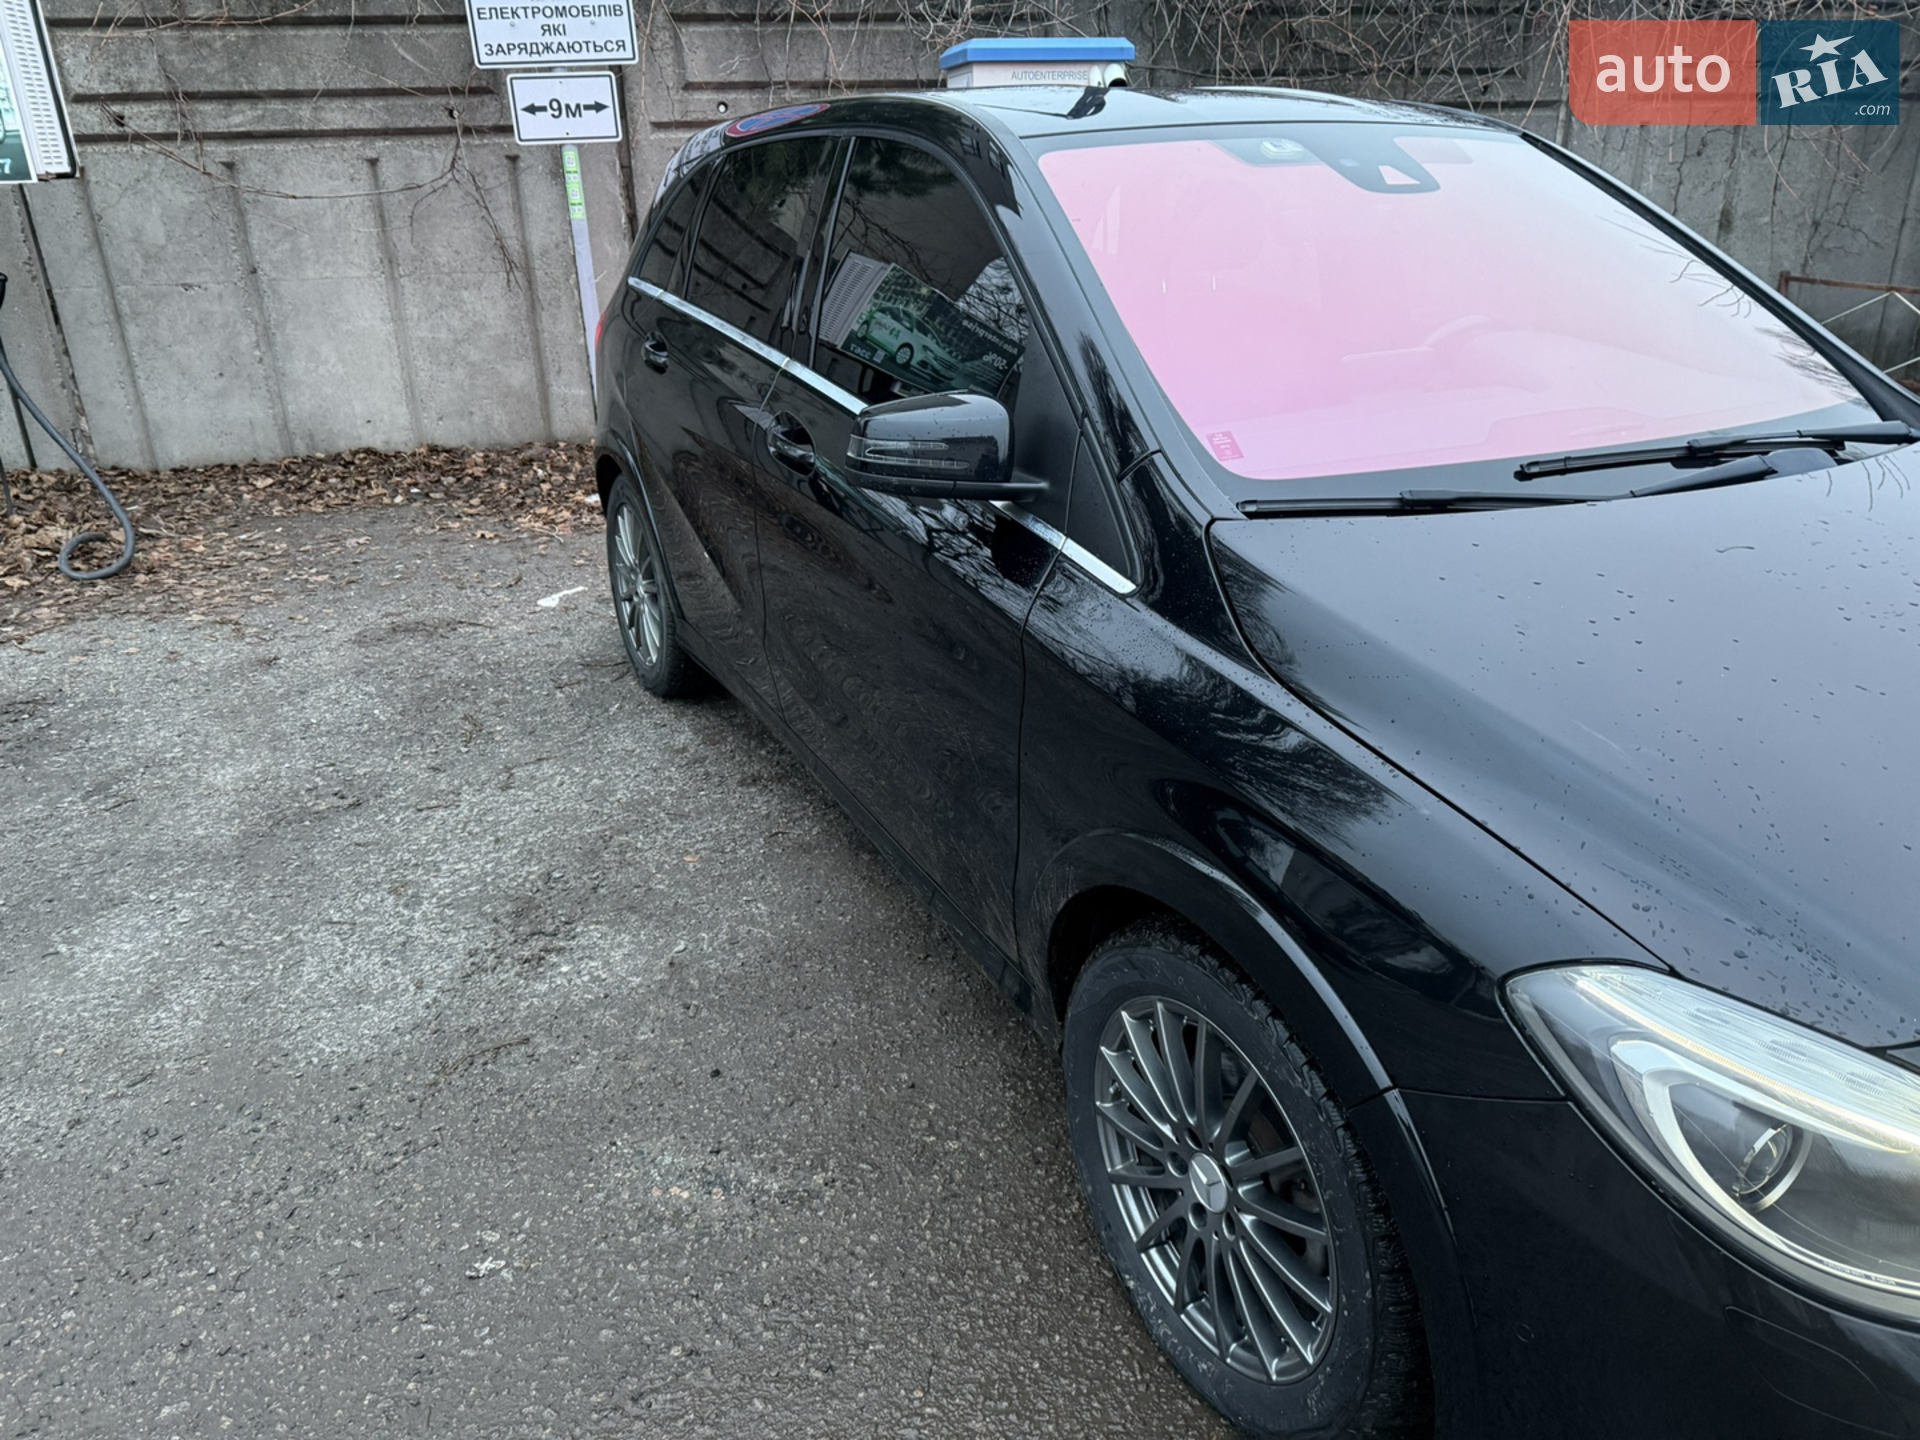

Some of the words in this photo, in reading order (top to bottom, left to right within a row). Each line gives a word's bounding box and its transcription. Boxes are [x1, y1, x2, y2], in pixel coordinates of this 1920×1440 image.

[476, 4, 624, 20] ЕЛЕКТРОМОБІЛІВ
[540, 23, 567, 37] ЯКІ
[483, 39, 627, 58] ЗАРЯДЖАЮТЬСЯ
[1011, 70, 1089, 81] AUTOENTERPRISE
[0, 158, 12, 174] 7
